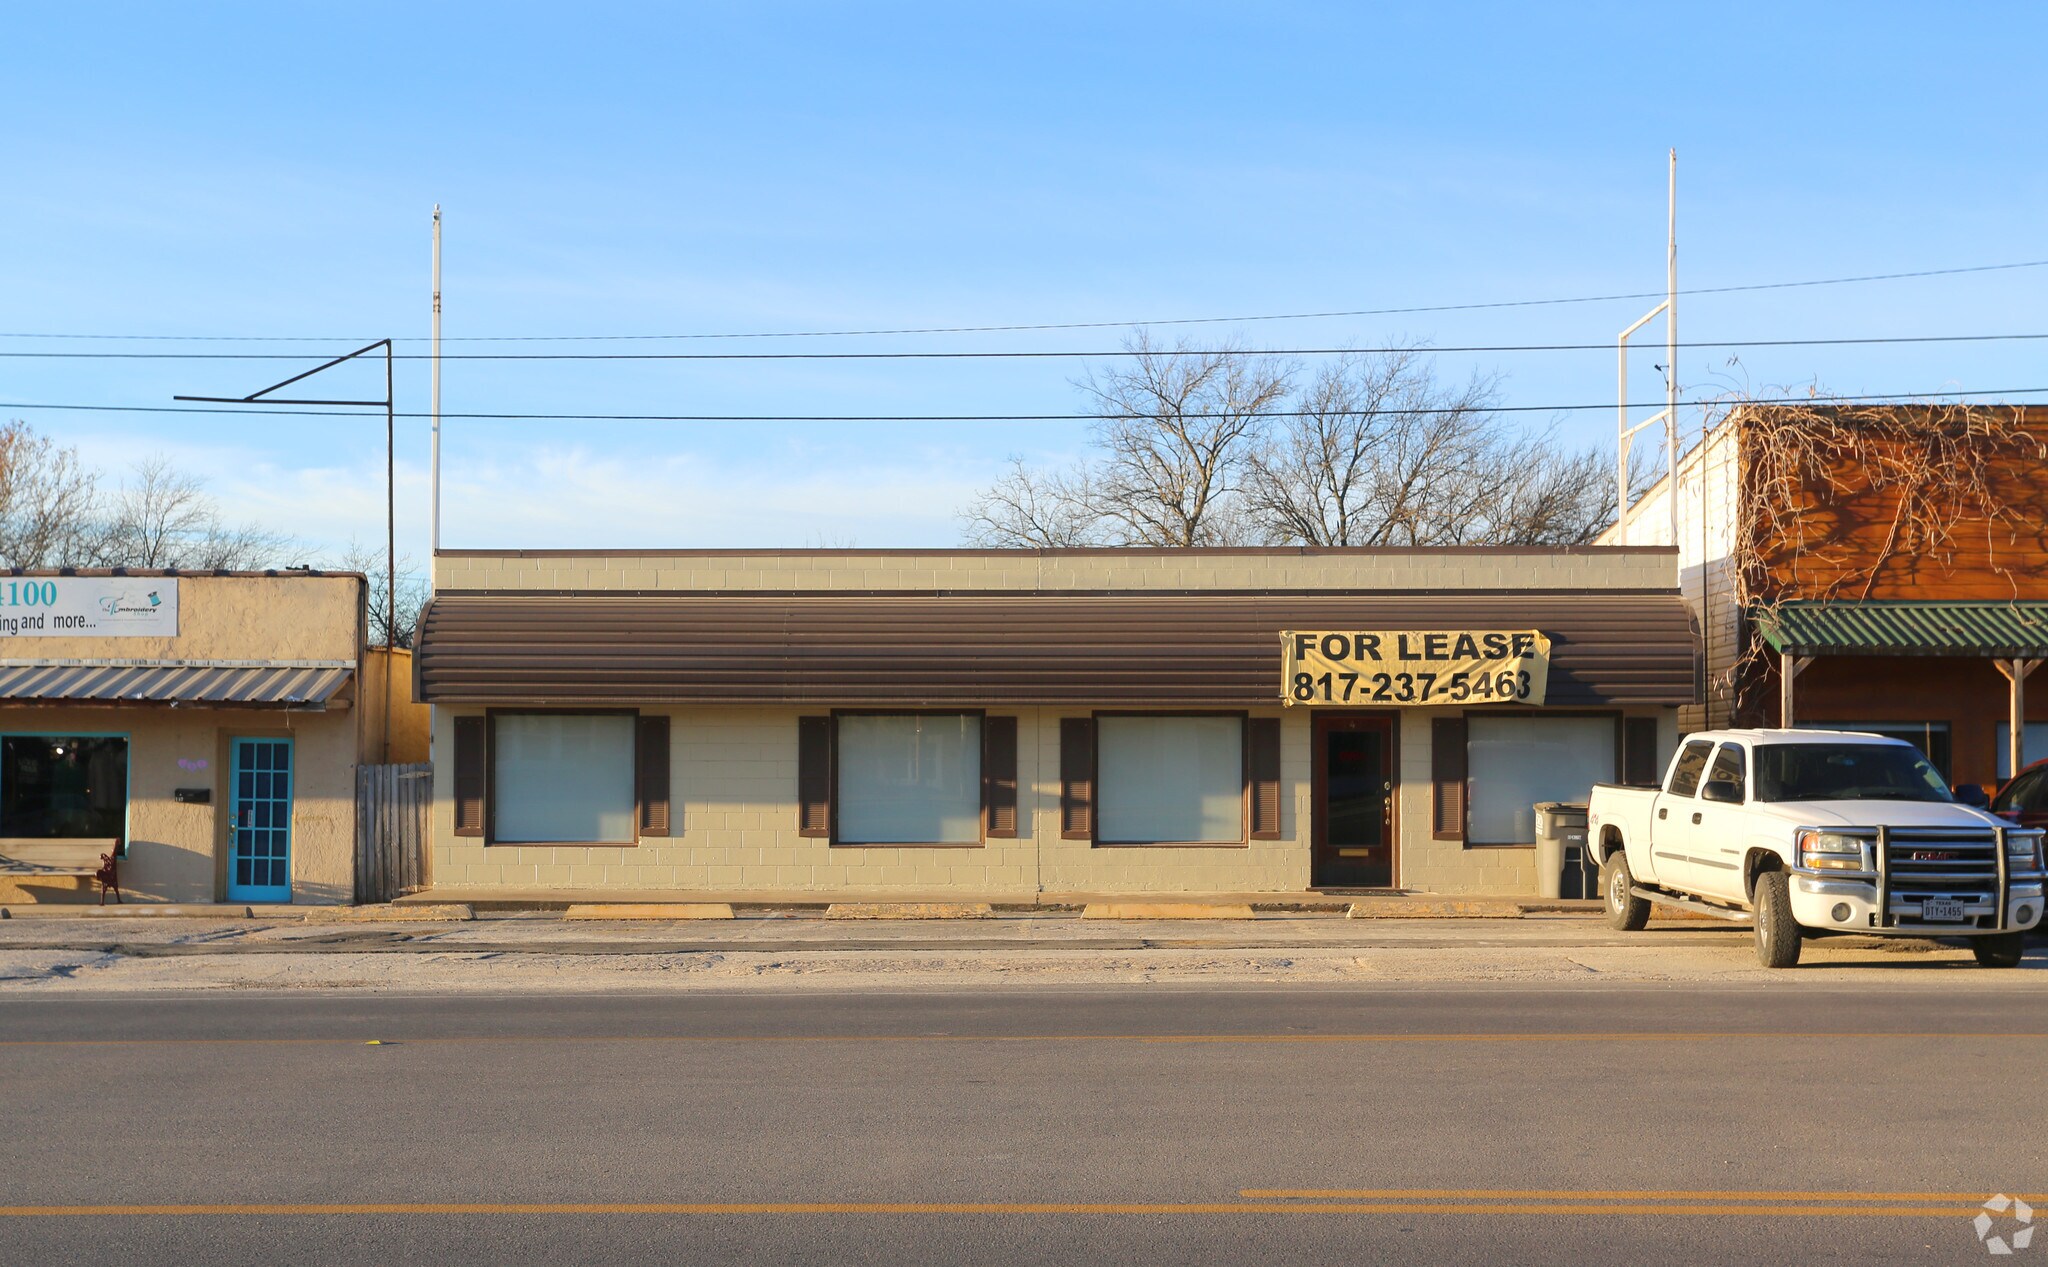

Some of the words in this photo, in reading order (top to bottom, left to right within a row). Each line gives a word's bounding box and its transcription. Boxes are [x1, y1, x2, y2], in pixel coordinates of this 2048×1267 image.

[21, 613, 44, 629] and
[53, 615, 96, 629] more...
[1295, 633, 1382, 661] FOR
[1398, 633, 1535, 661] LEASE
[1294, 670, 1532, 702] 817-237-5463
